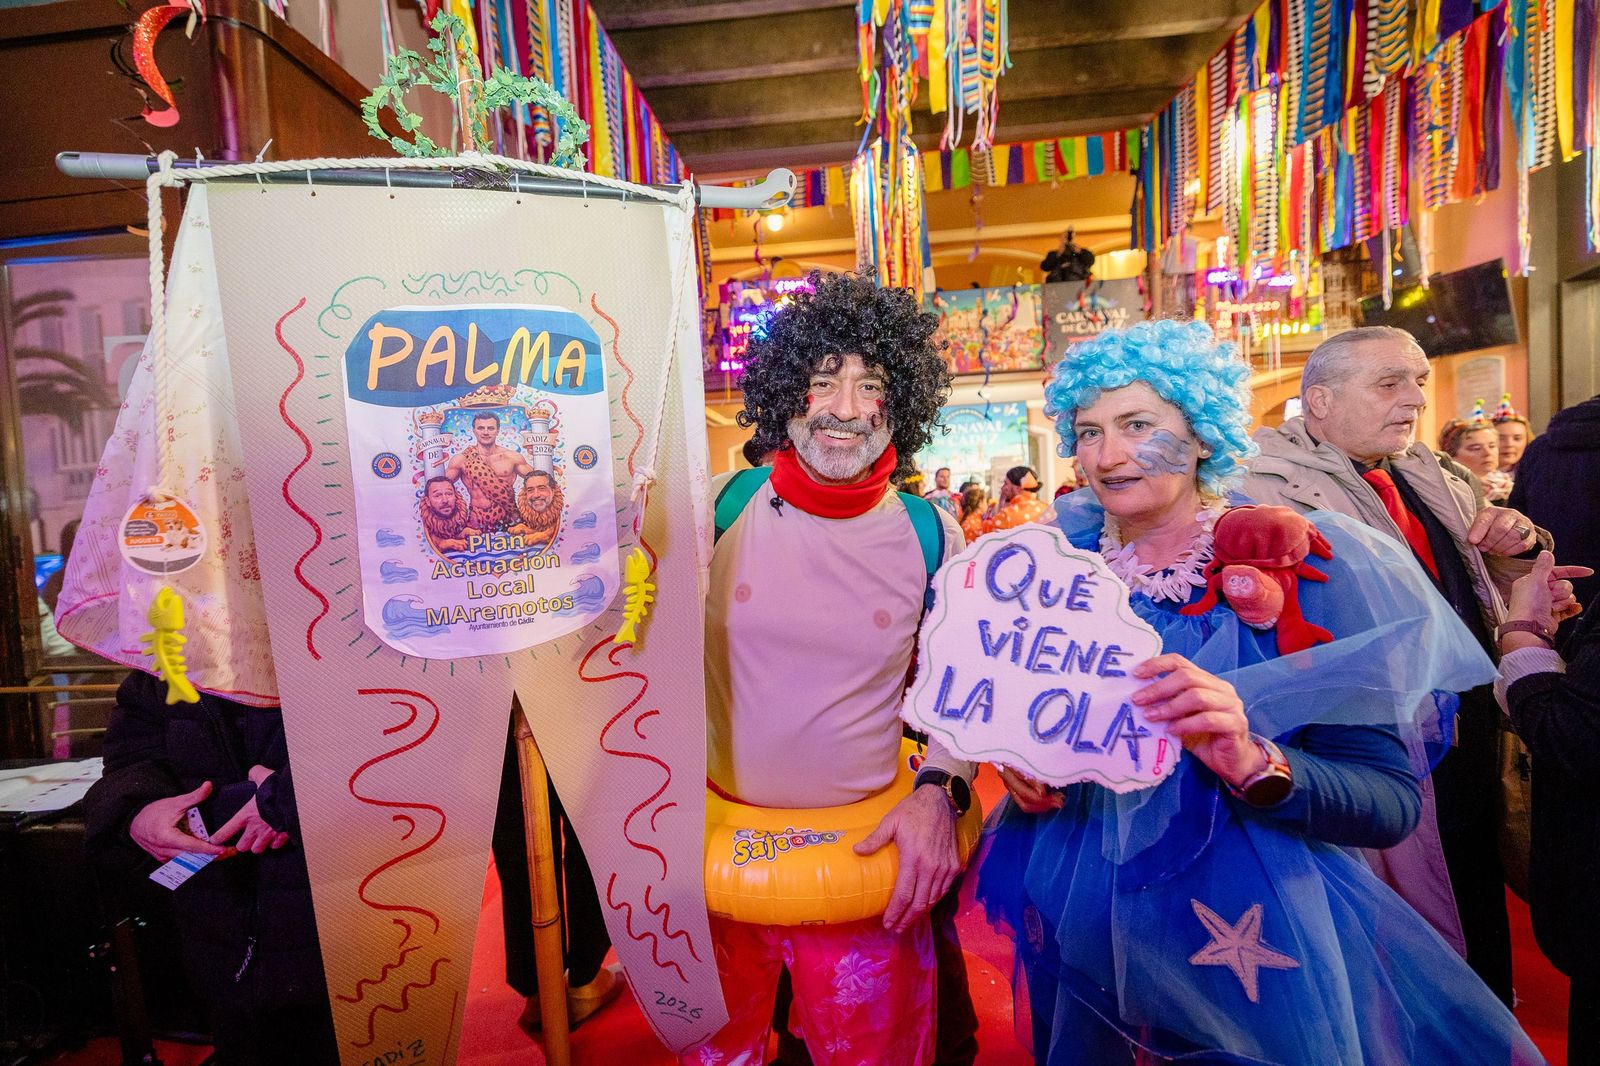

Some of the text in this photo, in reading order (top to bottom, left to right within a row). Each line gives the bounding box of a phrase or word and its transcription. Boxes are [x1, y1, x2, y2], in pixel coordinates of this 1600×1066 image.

[366, 321, 587, 391] PALMA
[418, 437, 447, 450] CARNAVAL
[428, 450, 439, 460] DE
[534, 446, 553, 454] 2026
[469, 532, 526, 553] Plan
[431, 551, 561, 580] Actuación
[467, 574, 535, 600] Local
[425, 594, 574, 627] MAremotos
[468, 621, 508, 632] Ayuntamiento
[518, 616, 535, 625] Cádiz
[932, 665, 994, 728] LA
[733, 836, 791, 866] Safe
[654, 990, 703, 1019] 2026
